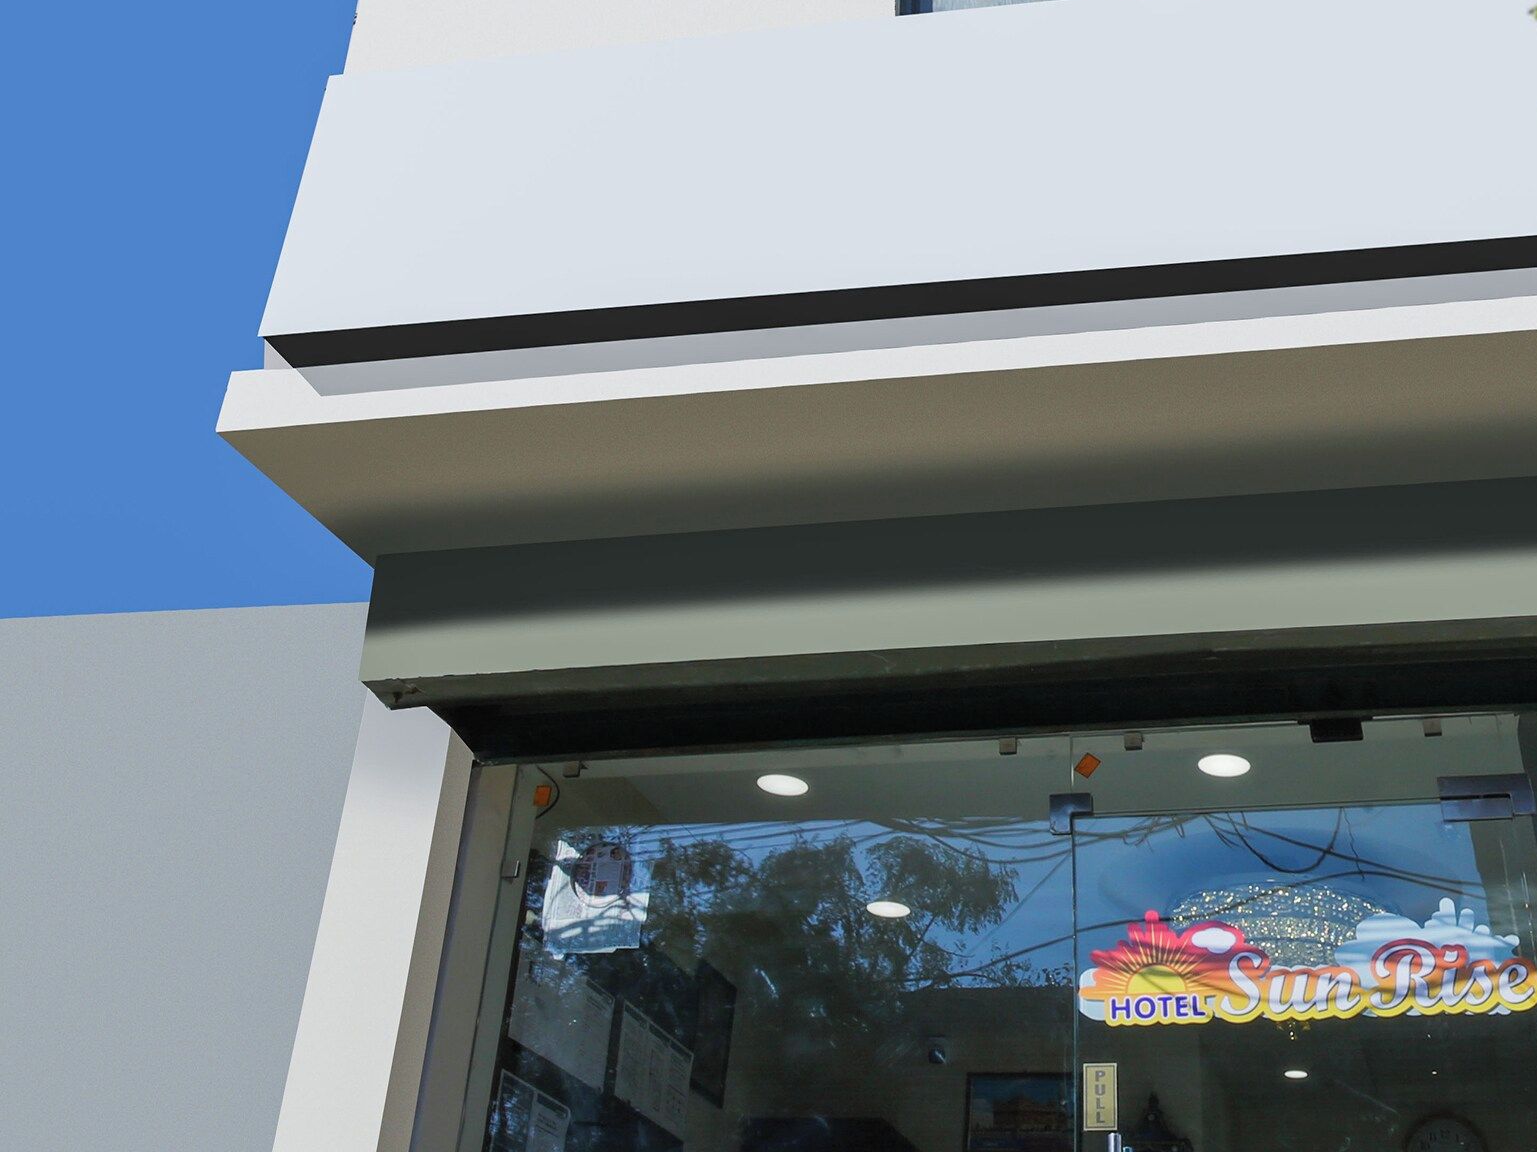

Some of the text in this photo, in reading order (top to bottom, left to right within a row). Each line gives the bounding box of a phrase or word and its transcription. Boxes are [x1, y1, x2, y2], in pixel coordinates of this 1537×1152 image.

[1110, 938, 1536, 1021] HOTEL Sun Rise
[1094, 1070, 1106, 1124] PULL
